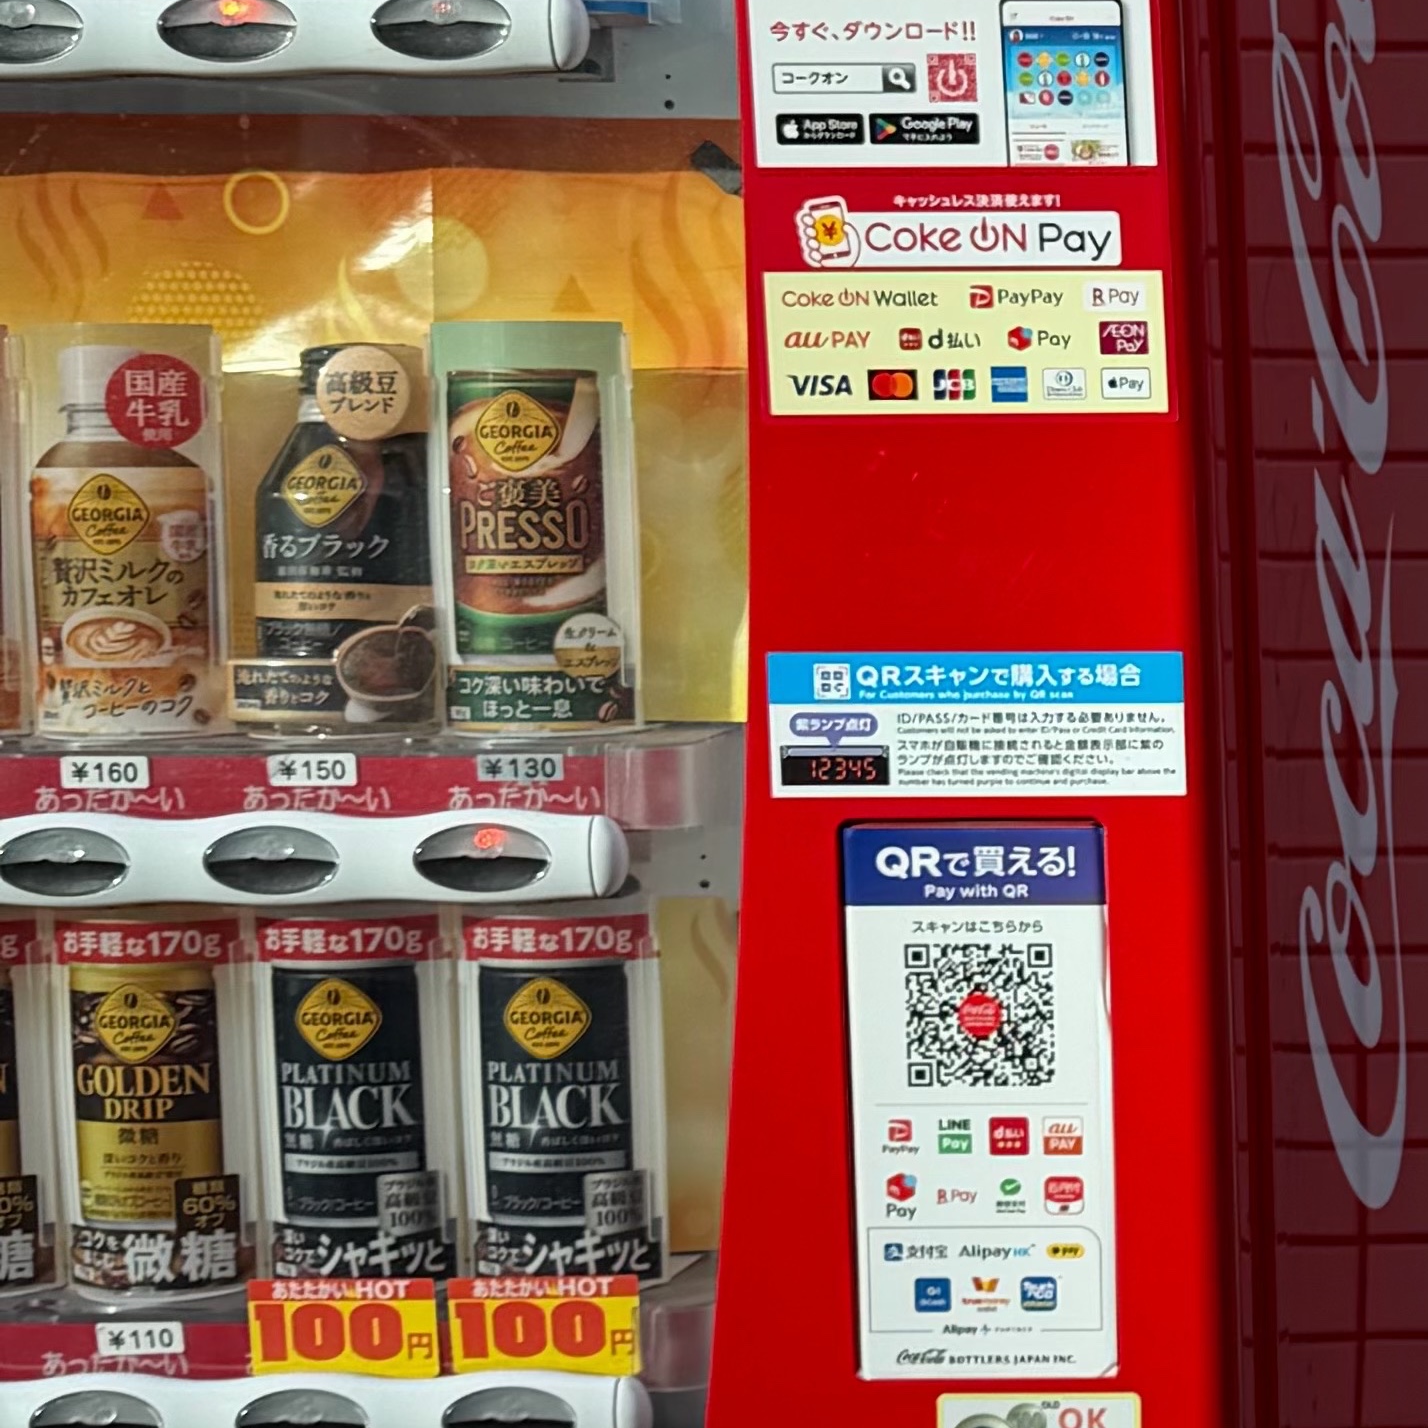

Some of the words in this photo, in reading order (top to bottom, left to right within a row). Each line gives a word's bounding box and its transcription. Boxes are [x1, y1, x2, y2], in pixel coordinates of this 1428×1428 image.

[781, 71, 849, 85] コークオン
[803, 119, 827, 132] App
[828, 118, 859, 131] Store
[901, 116, 946, 133] Google
[948, 117, 973, 133] Play
[865, 222, 962, 253] Coke
[1038, 222, 1113, 262] Pay
[781, 289, 834, 307] Coke
[873, 289, 939, 307] Wallet
[997, 288, 1064, 307] PayPay
[832, 330, 872, 348] PAY
[1037, 329, 1072, 350] Pay
[124, 369, 188, 398] 国産
[325, 370, 399, 395] 高級豆
[788, 374, 853, 397] VISA
[1119, 376, 1144, 391] Pay
[126, 399, 191, 428] 牛乳
[329, 397, 395, 414] ブレンド
[479, 425, 554, 439] GEORGIA
[460, 499, 590, 551] PRESSO
[262, 533, 390, 560] 香るブラック
[53, 557, 185, 585] 贅沢ミルクの
[62, 584, 168, 608] カフェオレ
[459, 676, 606, 696] コク深い味わいで
[856, 663, 1142, 688] QRスキャンで購入する場合
[83, 694, 194, 719] コーヒーのコク
[482, 699, 573, 719] ほっと一息
[71, 761, 138, 783] ¥160
[279, 759, 347, 781] ¥150
[485, 757, 557, 778] ¥130
[809, 757, 876, 780] 12345
[875, 845, 1076, 879] QRで買える!
[924, 883, 954, 901] Pay
[960, 883, 998, 898] with
[1003, 883, 1029, 899] QR
[912, 920, 1044, 934] スキャンはこちらから
[63, 929, 222, 959] お手軽な170g
[264, 925, 424, 954] お手軽な170g
[472, 925, 633, 954] お手軽な170g
[76, 1062, 213, 1098] GOLDEN
[281, 1060, 412, 1085] PLATINUM
[487, 1058, 619, 1083] PLATINUM
[104, 1097, 175, 1121] DRIP
[282, 1083, 418, 1131] BLACK
[487, 1082, 626, 1129] BLACK
[938, 1119, 971, 1131] LINE
[1050, 1140, 1076, 1150] PAY
[182, 1195, 237, 1215] 60%
[194, 1213, 225, 1228] オフ
[124, 1228, 238, 1285] 微糖
[319, 1230, 447, 1278] シャキッと
[522, 1229, 652, 1276] シャキッと
[355, 1280, 411, 1299] HOT
[557, 1278, 613, 1296] HOT
[108, 1328, 174, 1350] ¥110
[254, 1301, 434, 1362] 100円
[454, 1299, 634, 1360] 100円
